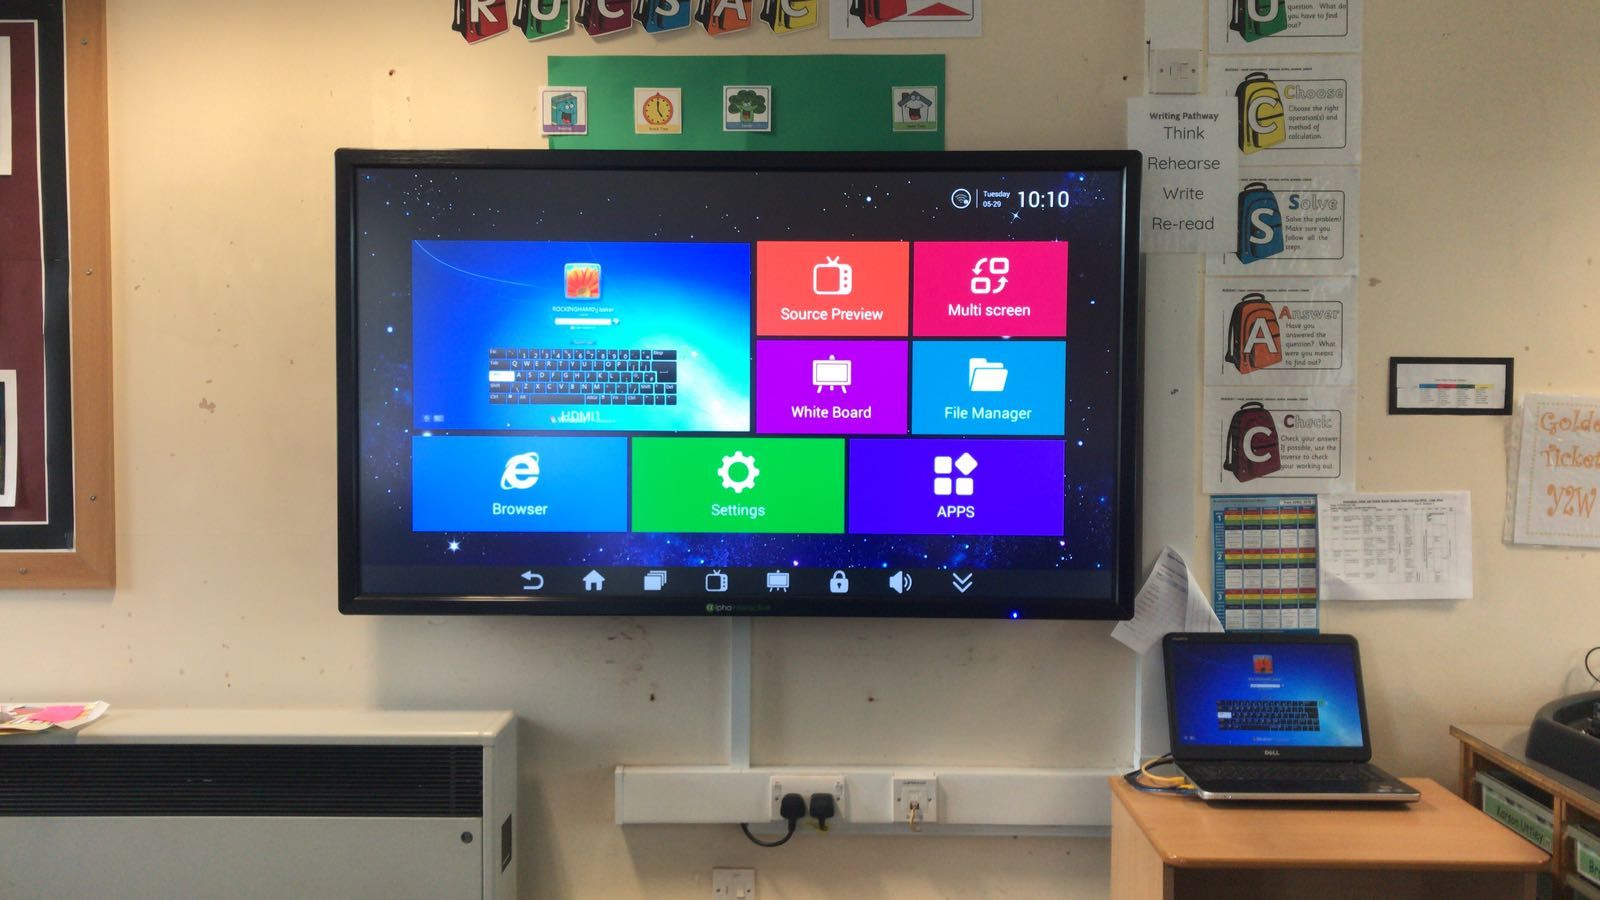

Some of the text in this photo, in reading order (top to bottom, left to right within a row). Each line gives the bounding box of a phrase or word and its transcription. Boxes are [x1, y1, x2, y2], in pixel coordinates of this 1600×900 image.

[1287, 13, 1300, 21] you
[1283, 84, 1345, 100] Choose
[1248, 95, 1279, 134] C
[1288, 104, 1340, 113] Choose the right
[1149, 111, 1220, 122] Writing Pathway
[1163, 125, 1206, 140] Think
[1288, 123, 1321, 132] method of
[1147, 156, 1221, 170] Rehearse
[983, 190, 1010, 199] Tuesday
[1018, 190, 1070, 208] 10:10
[1162, 187, 1205, 201] Write
[983, 200, 1002, 208] 05-29
[1288, 194, 1339, 211] Solve
[1152, 216, 1215, 230] Re-read
[1249, 207, 1275, 245] S
[1319, 226, 1331, 234] you
[1285, 234, 1304, 242] follow
[780, 307, 884, 321] Source Preview
[947, 303, 1031, 317] Multi screen
[1279, 305, 1340, 320] Answer
[1243, 317, 1279, 353] A
[1293, 359, 1306, 367] find
[791, 405, 872, 419] White Board
[944, 405, 1032, 422] File Manager
[1283, 413, 1333, 429] Check
[1242, 425, 1273, 463] C
[1280, 434, 1300, 442] Check
[1280, 453, 1301, 461] inverse
[1296, 462, 1321, 471] working
[492, 502, 549, 517] Browser
[710, 503, 766, 519] Settings
[936, 505, 976, 519] APPS
